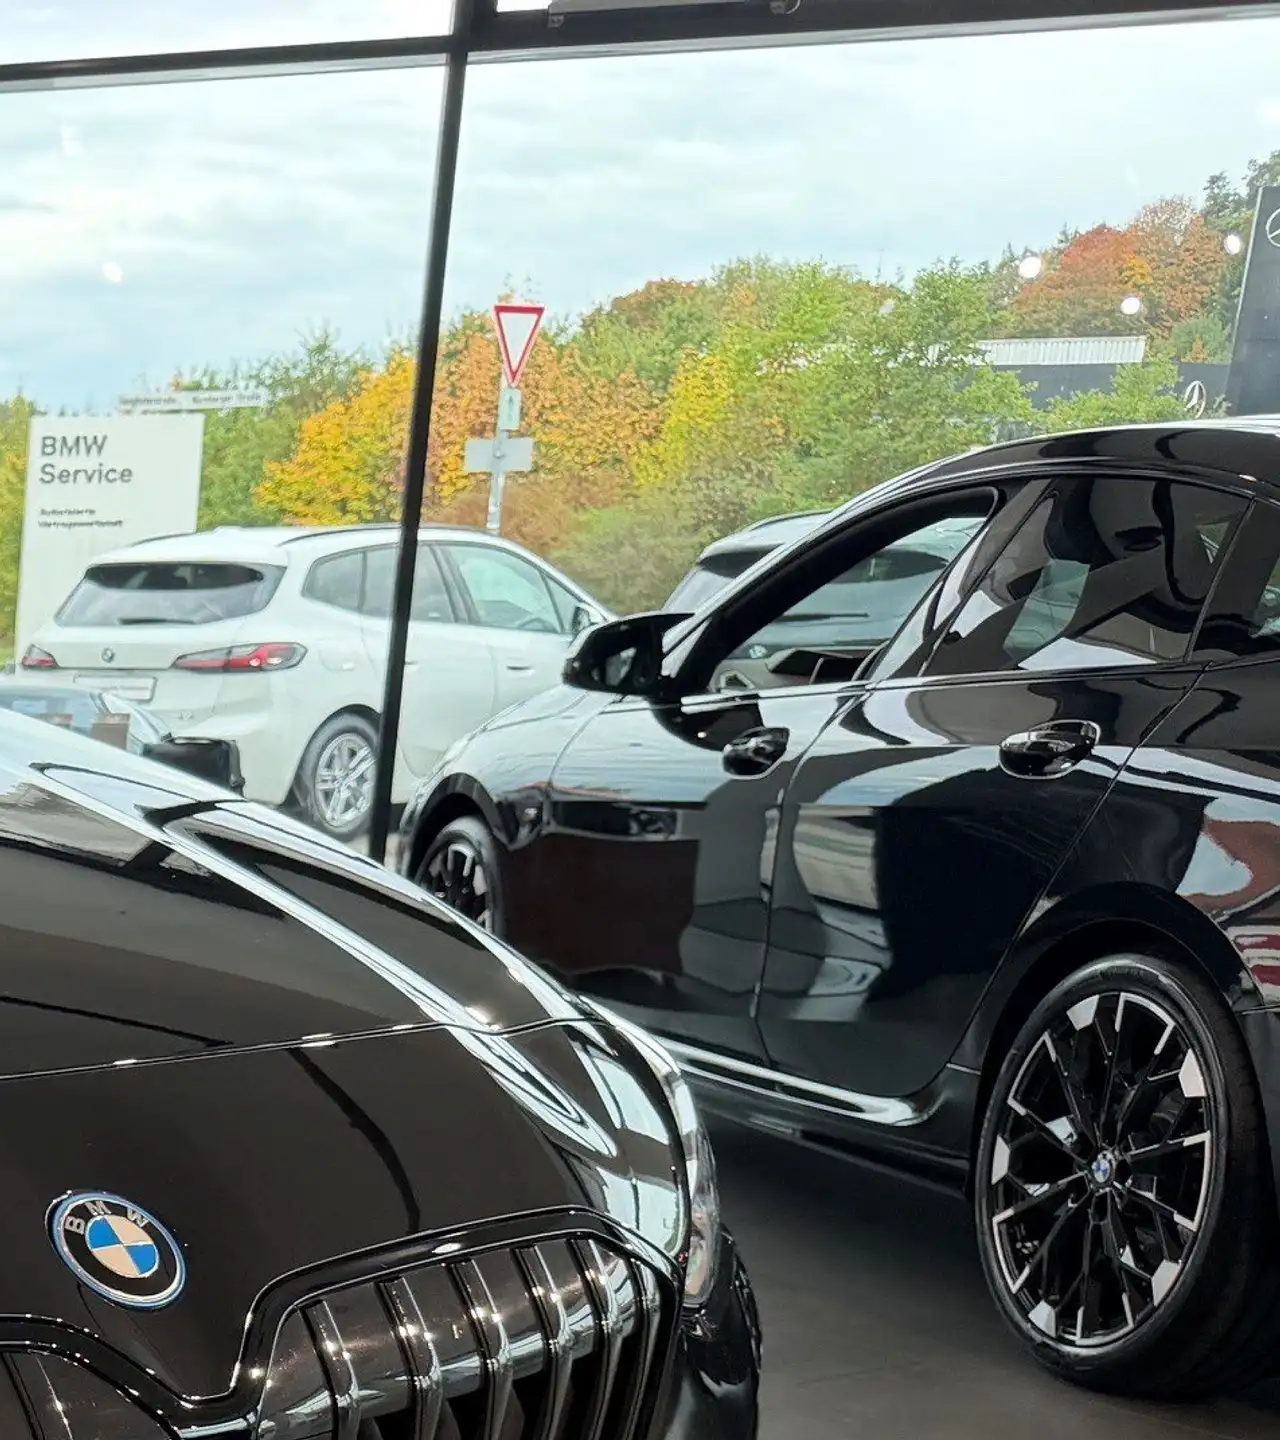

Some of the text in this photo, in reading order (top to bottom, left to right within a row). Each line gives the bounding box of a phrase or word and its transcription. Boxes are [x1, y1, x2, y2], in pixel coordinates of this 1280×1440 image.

[40, 435, 107, 457] BMW
[39, 463, 133, 485] Service
[64, 1200, 151, 1236] BMW
